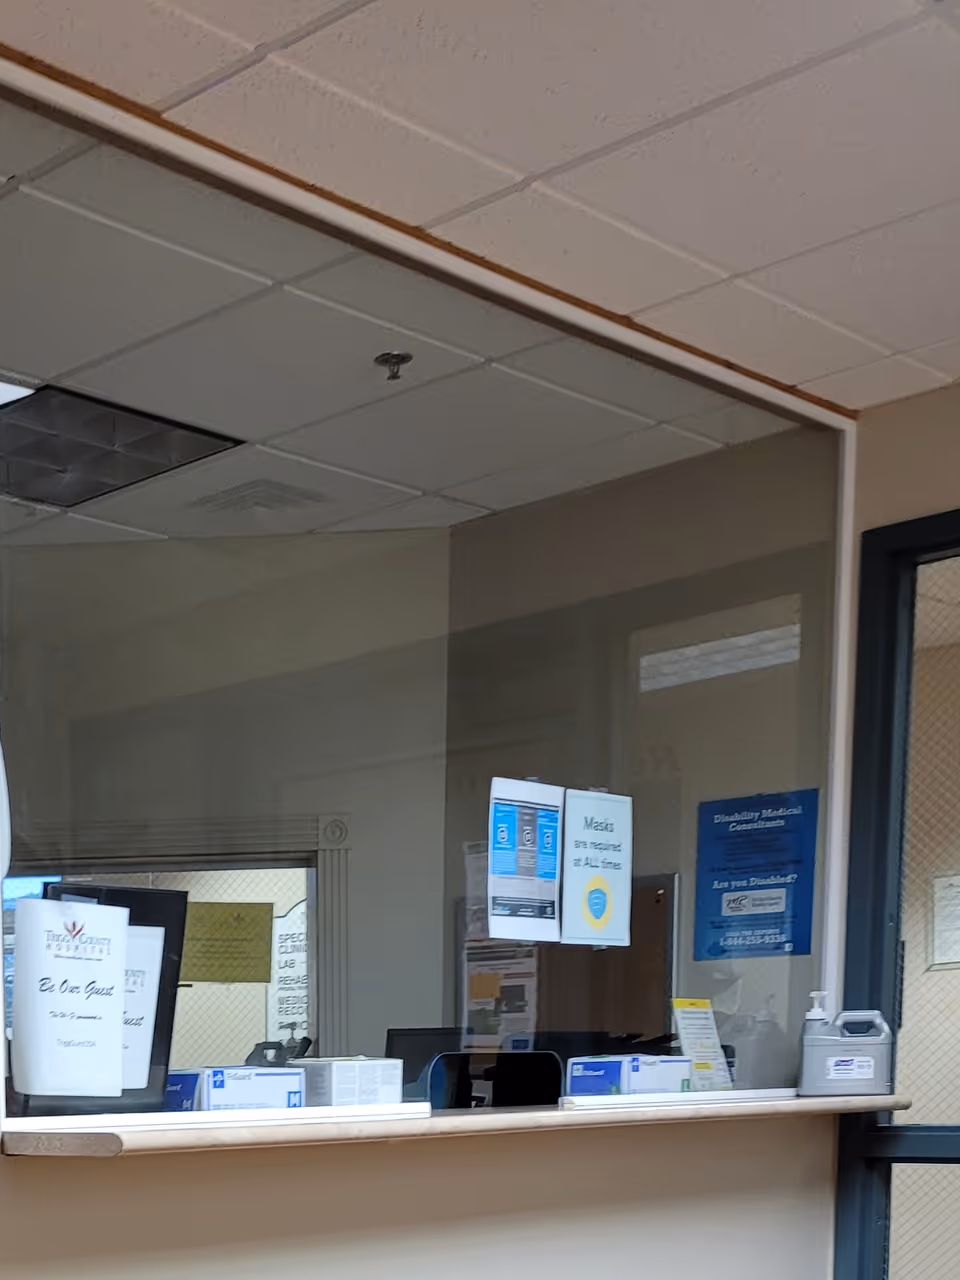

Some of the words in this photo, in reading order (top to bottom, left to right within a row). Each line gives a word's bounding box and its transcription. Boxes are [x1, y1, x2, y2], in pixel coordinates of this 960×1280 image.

[713, 811, 760, 823] Disability
[761, 806, 802, 818] Medical
[583, 816, 614, 832] Masks
[729, 819, 785, 831] Consultants
[574, 840, 588, 849] are
[589, 841, 622, 853] required
[573, 858, 582, 867] at
[583, 857, 600, 869] ALL
[601, 858, 623, 870] times
[712, 880, 729, 889] Are
[730, 879, 748, 890] you
[749, 874, 798, 886] Disabled?
[46, 943, 112, 956] HOSPITAL
[278, 958, 296, 970] LAB
[38, 977, 55, 993] Be
[59, 979, 81, 994] Our
[84, 980, 115, 1000] Guest
